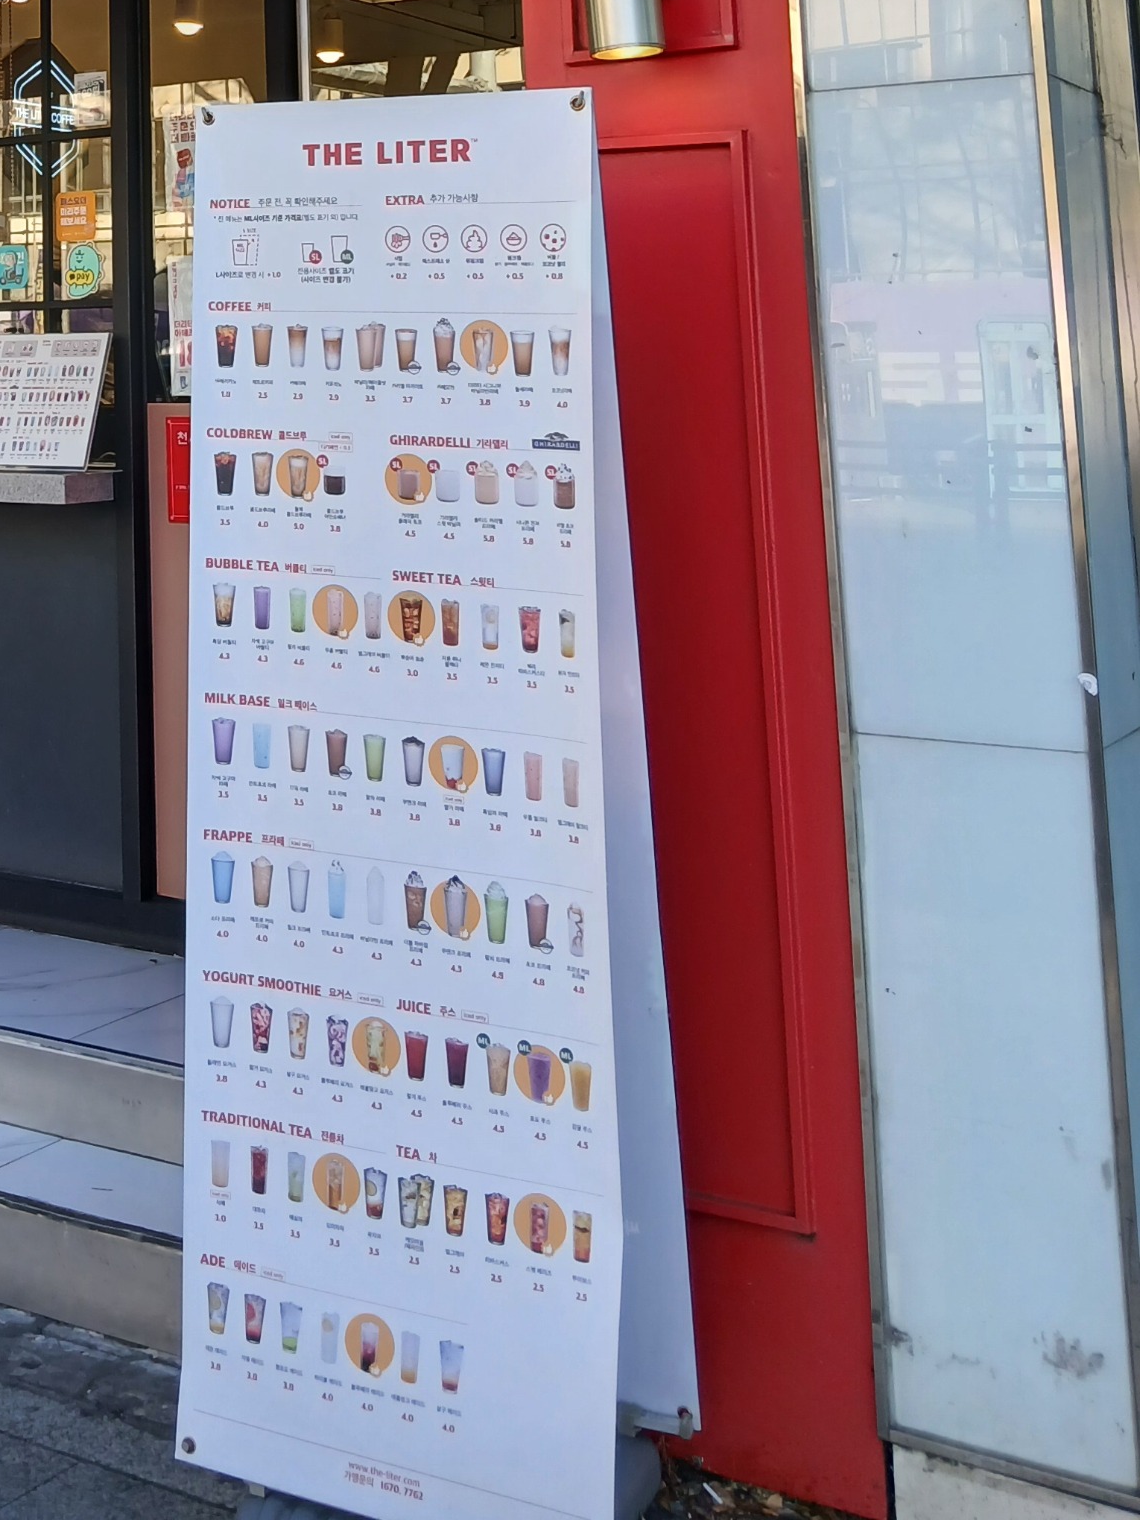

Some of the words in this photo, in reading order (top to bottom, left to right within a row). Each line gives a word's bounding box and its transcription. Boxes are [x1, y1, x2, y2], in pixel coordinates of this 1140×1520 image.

[51, 112, 75, 124] COFFE
[302, 142, 363, 167] THE
[377, 138, 472, 164] LITER
[210, 199, 251, 209] NOTICE
[385, 195, 425, 205] EXTRA
[76, 272, 90, 282] pay
[208, 301, 251, 311] COFFEE
[257, 302, 271, 311] 커피
[207, 428, 272, 440] COLDBREW
[390, 435, 470, 448] GHIRARDELLI
[206, 558, 253, 570] BUBBLE
[256, 560, 279, 572] TEA
[392, 571, 434, 583] SWEET
[437, 573, 461, 585] TEA
[205, 693, 235, 705] MILK
[239, 695, 270, 707] BASE
[203, 829, 252, 842] FRAPPE
[202, 970, 254, 986] YOGURT
[258, 976, 322, 996] SMOOTHIE
[397, 998, 431, 1015] JUICE
[440, 1005, 456, 1017] 주스
[201, 1110, 285, 1134] TRADITIONAL
[288, 1123, 312, 1140] TEA
[396, 1145, 421, 1162] TEA
[200, 1253, 226, 1269] ADE
